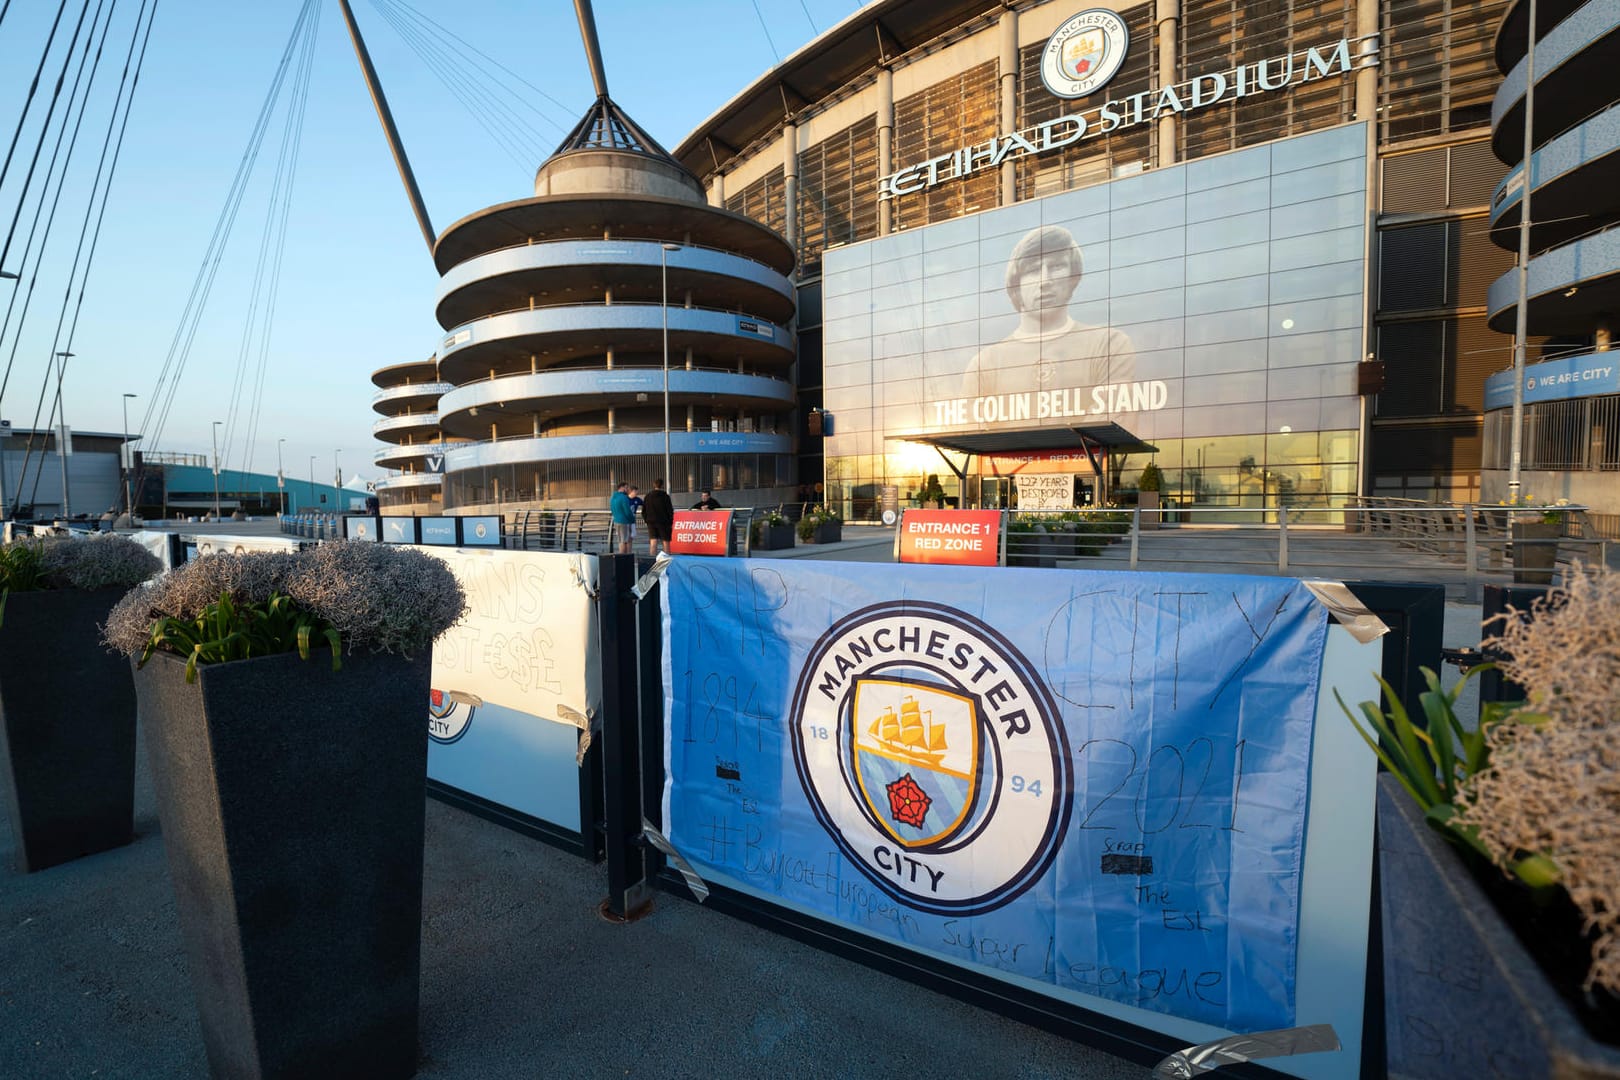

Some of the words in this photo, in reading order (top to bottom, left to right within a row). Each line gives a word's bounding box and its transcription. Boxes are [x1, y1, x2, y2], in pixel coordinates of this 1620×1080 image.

[1050, 15, 1118, 53] MANCHESTER
[1071, 79, 1096, 93] CITY
[889, 112, 1088, 196] ETIHAD
[1100, 38, 1354, 134] STADIUM
[1540, 377, 1555, 386] WE
[1557, 372, 1580, 385] ARE
[1582, 367, 1612, 381] CITY
[935, 400, 969, 425] THE
[973, 393, 1030, 422] COLIN
[1036, 387, 1086, 418] BELL
[1091, 380, 1168, 414] STAND
[426, 457, 442, 472] V
[1049, 455, 1070, 463] RED
[1040, 476, 1069, 487] YEARS
[1021, 488, 1069, 499] DESTROYED
[674, 521, 715, 531] ENTRANCE
[718, 522, 723, 531] 1
[909, 522, 979, 535] ENTRANCE
[984, 522, 990, 534] 1
[677, 533, 694, 543] RED
[695, 533, 718, 543] ZONE
[915, 537, 940, 550] RED
[944, 538, 982, 551] ZONE
[1044, 589, 1291, 710] CITY
[818, 626, 1032, 740] MANCHESTER
[428, 718, 450, 736] CITY
[810, 725, 828, 740] 18
[682, 670, 774, 752] 1894
[1078, 736, 1247, 834] 2021
[1010, 775, 1042, 797] 94
[873, 845, 945, 893] CITY
[1136, 885, 1174, 905] The
[1162, 908, 1213, 933] ESL
[942, 920, 1028, 963] Super
